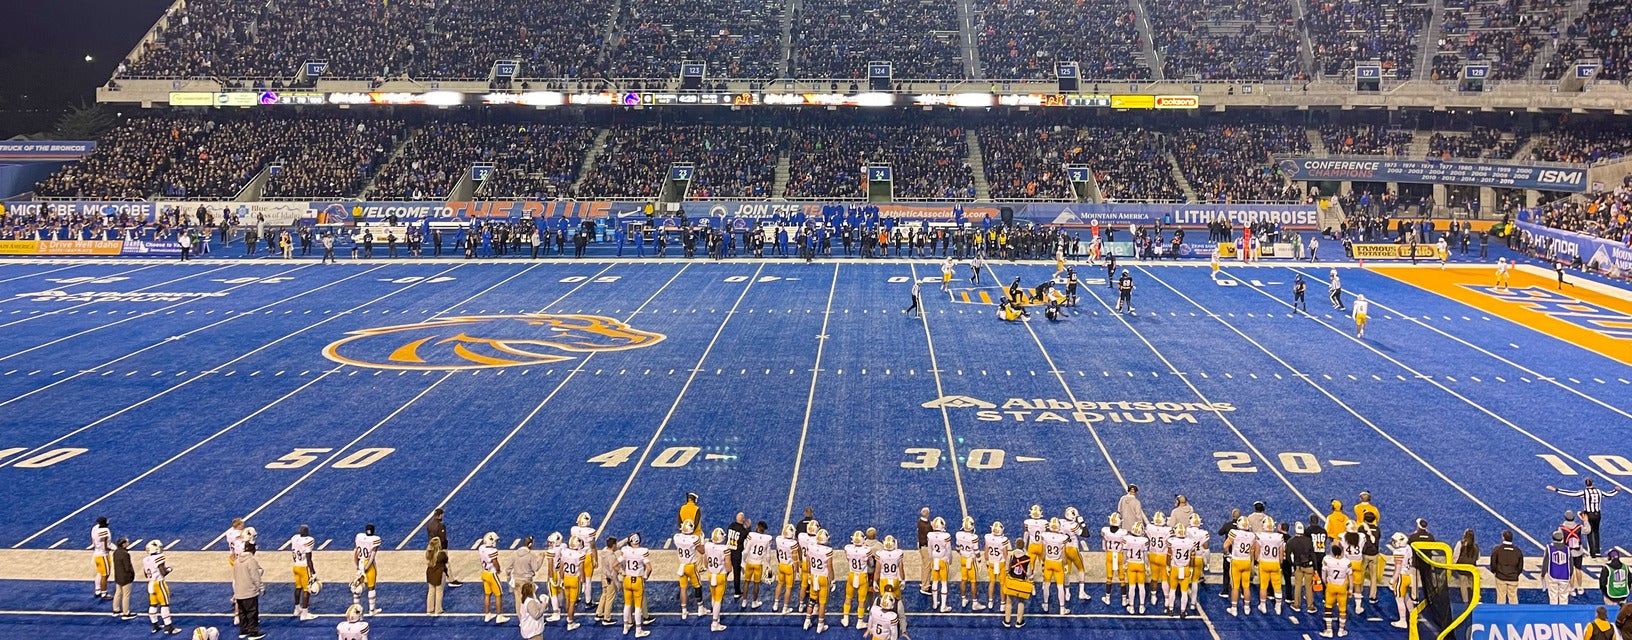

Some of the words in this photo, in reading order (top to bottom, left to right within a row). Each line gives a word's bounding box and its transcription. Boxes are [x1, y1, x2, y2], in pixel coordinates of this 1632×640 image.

[1304, 161, 1380, 171] CONFERENCE
[1384, 162, 1398, 171] 1973
[479, 169, 488, 177] 22
[1308, 169, 1374, 178] CHAMPIONS
[1537, 170, 1582, 186] ISMI
[1422, 174, 1437, 184] 2010
[1461, 176, 1476, 186] 2014
[1481, 177, 1495, 186] 2017
[434, 206, 453, 218] TO
[445, 201, 515, 218] THE
[734, 204, 770, 216] JOIN
[772, 204, 800, 216] THE
[1080, 212, 1117, 220] MOUNTAIN
[50, 240, 72, 248] Drive
[75, 240, 93, 248] Well
[95, 240, 119, 248] Idaho
[1534, 234, 1579, 257] HYNDAI
[1003, 398, 1237, 412] Albertsons
[977, 410, 1199, 424] STADIUM
[1311, 533, 1326, 543] BIG
[753, 544, 763, 556] 18
[1108, 541, 1121, 551] 17
[1239, 542, 1251, 554] 92
[1264, 544, 1278, 558] 90
[1130, 548, 1142, 559] 14
[1175, 549, 1189, 561] 54
[564, 562, 576, 574] 20
[811, 557, 823, 570] 82
[852, 558, 862, 570] 81
[883, 562, 897, 573] 80
[1333, 569, 1340, 580] 7
